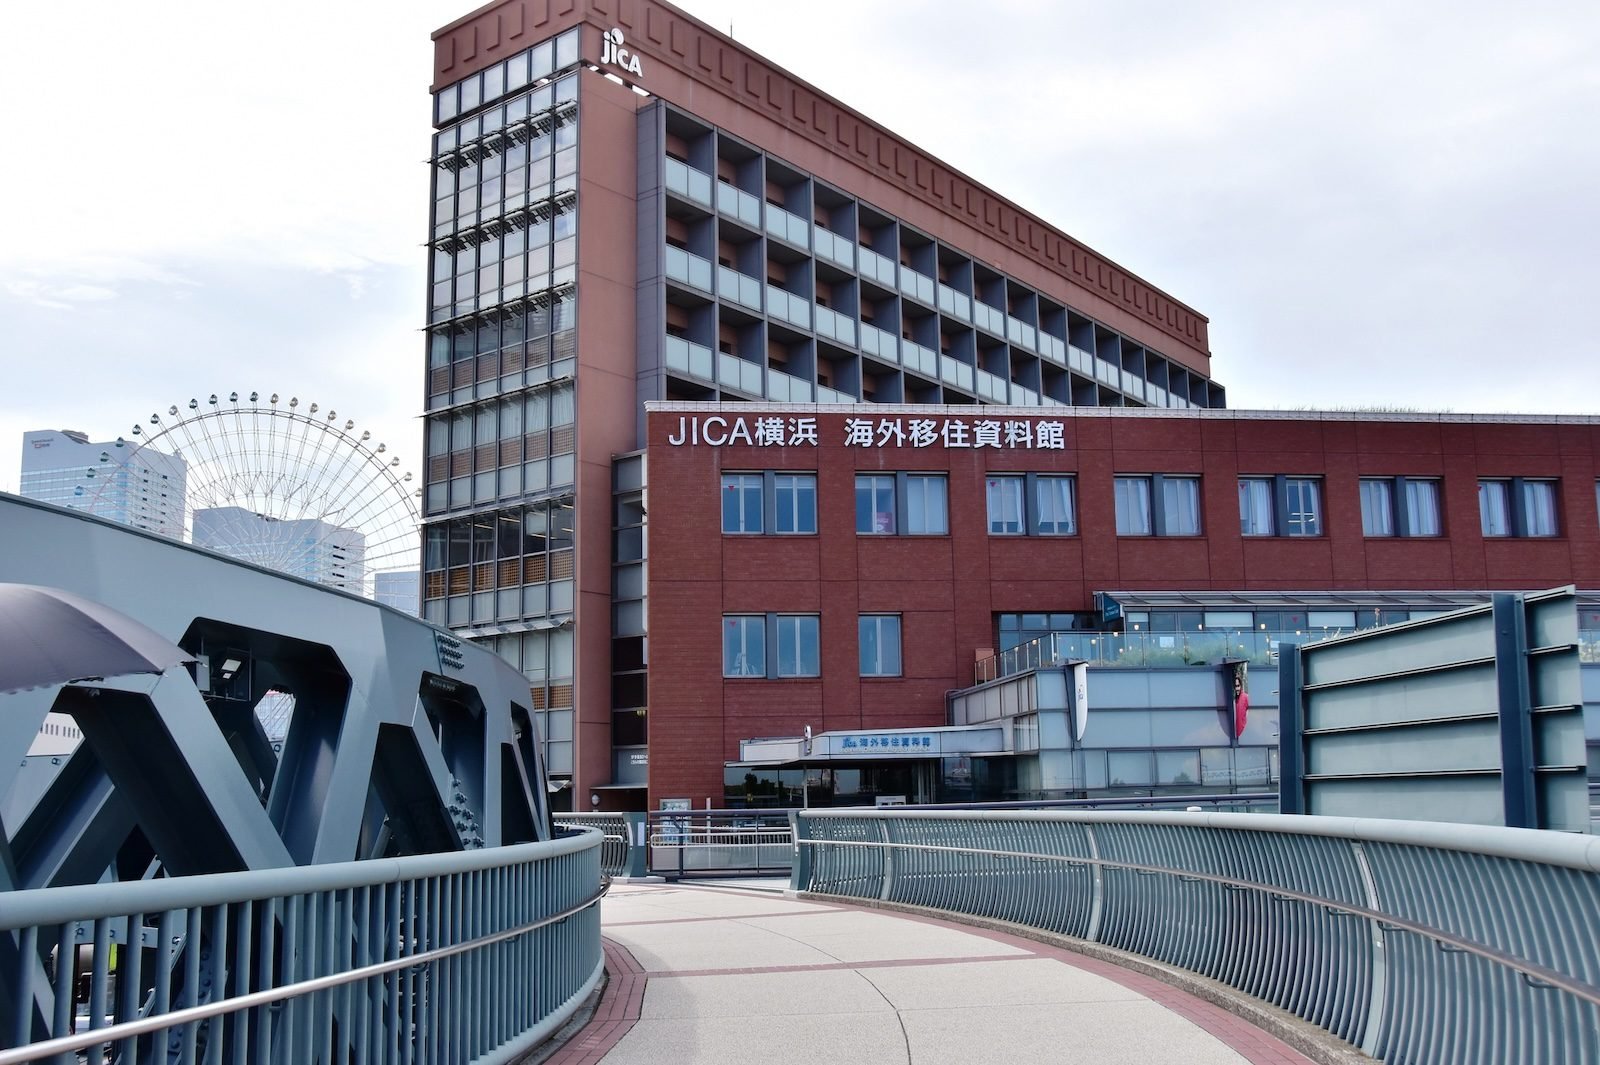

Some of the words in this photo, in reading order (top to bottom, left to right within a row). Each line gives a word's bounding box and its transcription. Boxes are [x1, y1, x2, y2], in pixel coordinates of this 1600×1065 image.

[668, 416, 818, 447] JICA横浜
[844, 418, 1065, 449] 海外移住資料館
